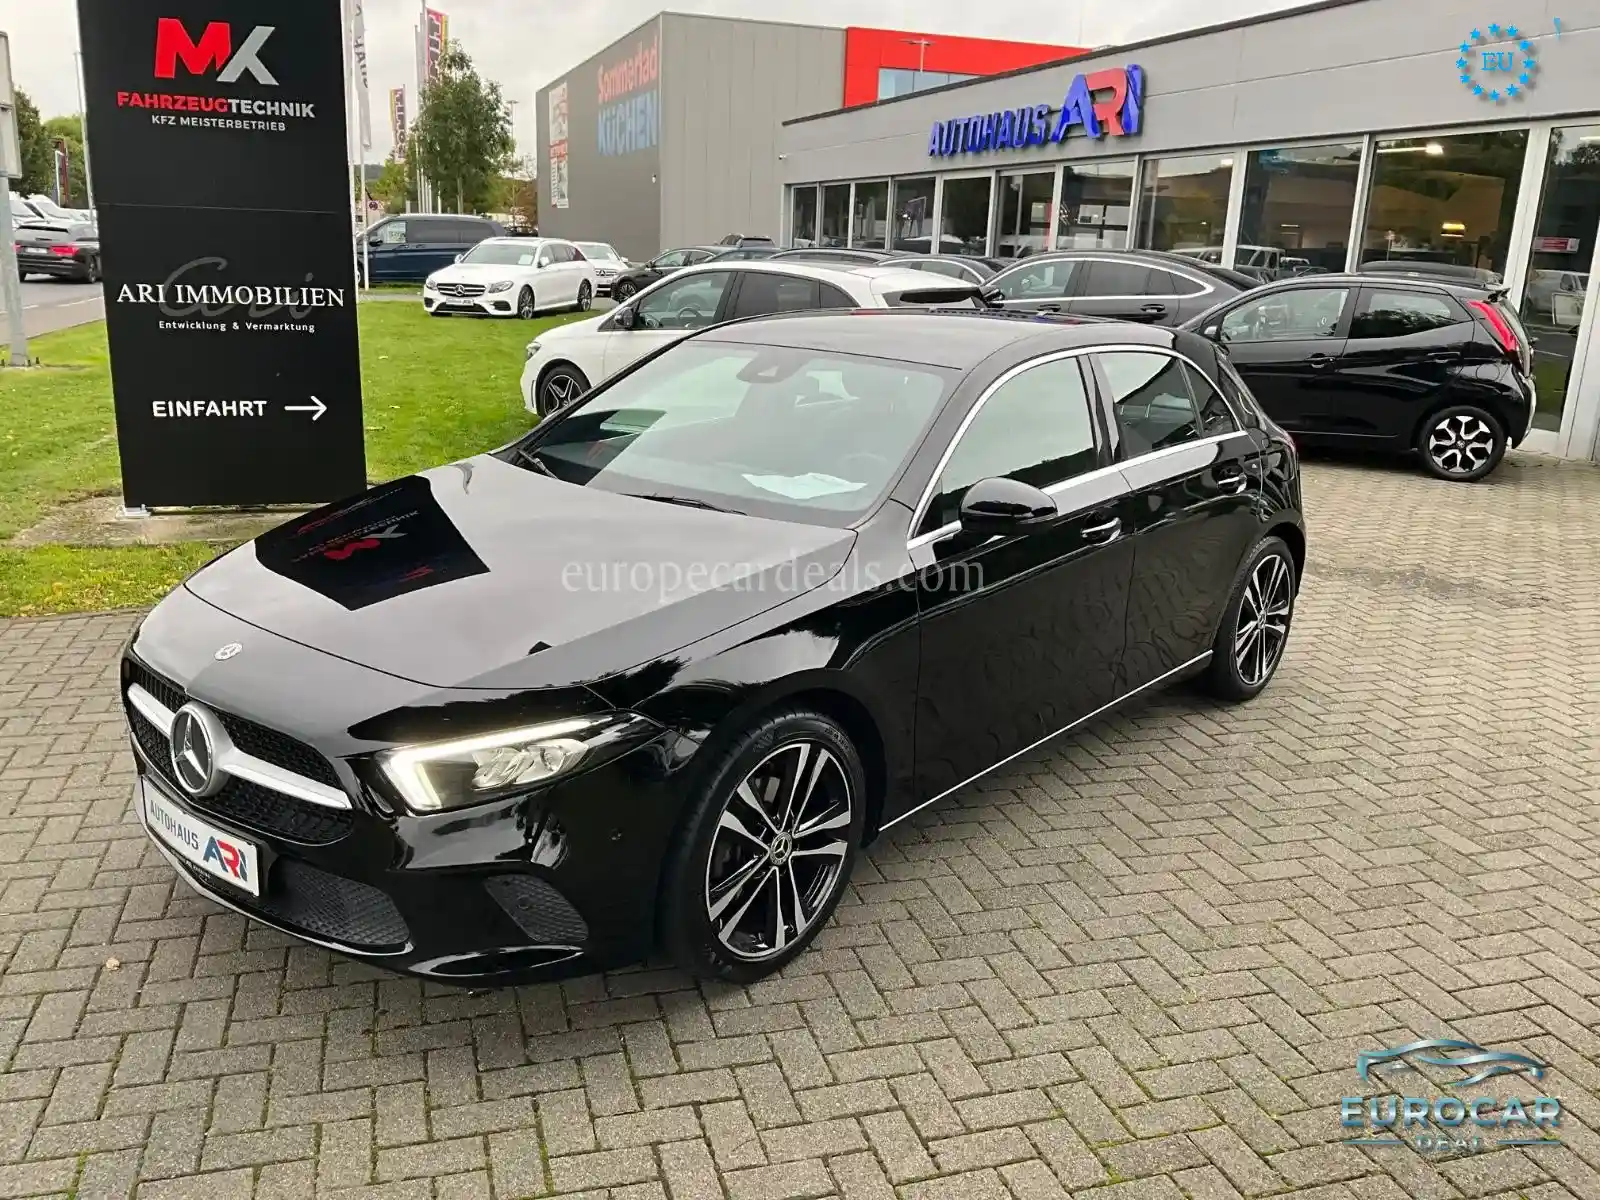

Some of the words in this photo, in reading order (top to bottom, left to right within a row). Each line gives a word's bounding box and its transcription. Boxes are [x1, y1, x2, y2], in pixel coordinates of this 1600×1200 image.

[154, 17, 280, 86] MK
[117, 91, 316, 119] FAHRZEUGTECHNIK
[928, 103, 1050, 157] AUTOHAUS
[1050, 63, 1145, 144] ARI
[151, 114, 177, 126] KFZ
[180, 116, 286, 132] MEISTERBETRIEB
[117, 284, 167, 304] ARI
[174, 284, 345, 308] IMMOBILIEN
[159, 320, 227, 332] Entwicklung
[232, 322, 240, 330] &
[245, 322, 315, 333] Vermarktung
[152, 400, 267, 418] EINFAHRT
[150, 799, 199, 850] AUTOHAUS
[203, 835, 248, 882] ARI
